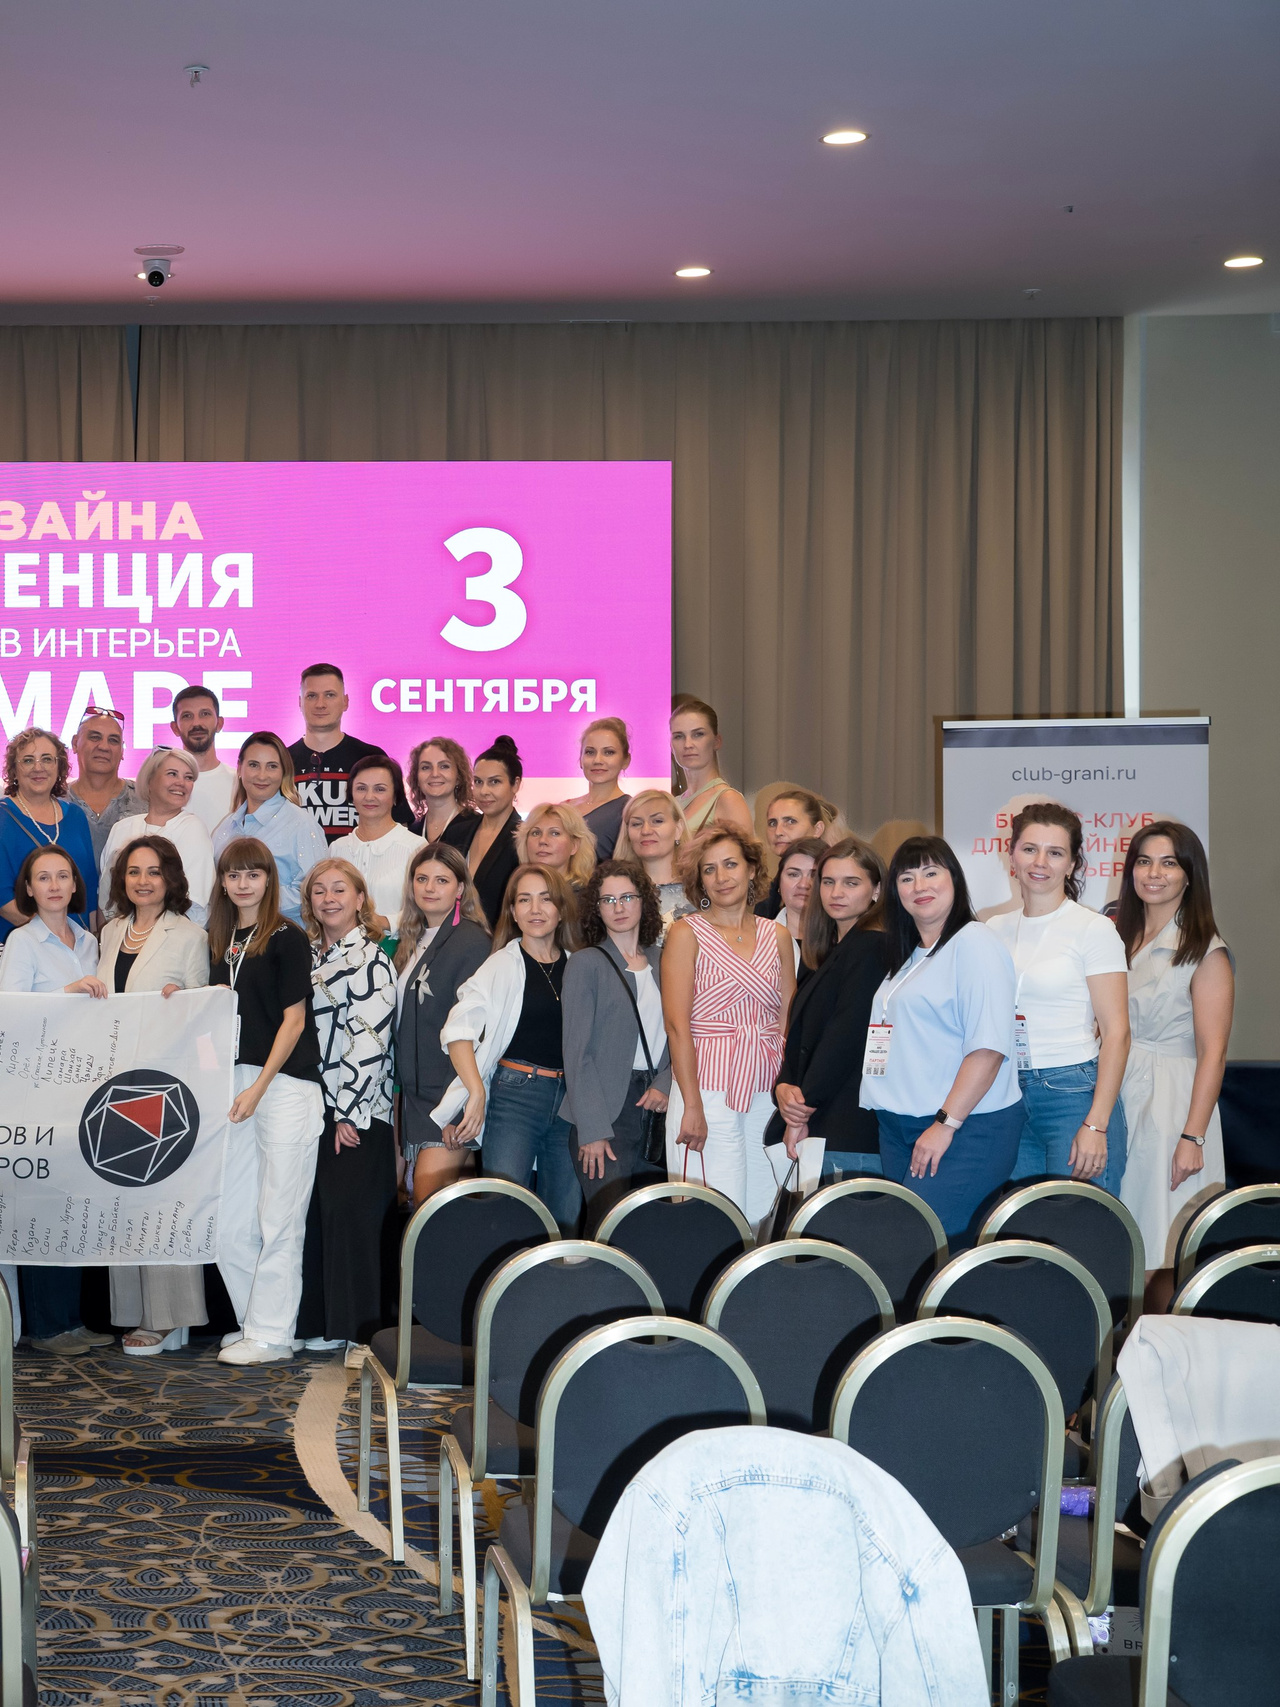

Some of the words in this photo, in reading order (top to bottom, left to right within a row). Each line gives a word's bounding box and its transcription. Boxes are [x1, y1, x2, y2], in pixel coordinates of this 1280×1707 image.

[439, 527, 528, 652] 3
[33, 628, 242, 658] ИНТЕРЬЕРА
[371, 678, 597, 713] СЕНТЯБРЯ
[1011, 766, 1137, 785] club-grani.ru
[36, 1126, 54, 1146] И
